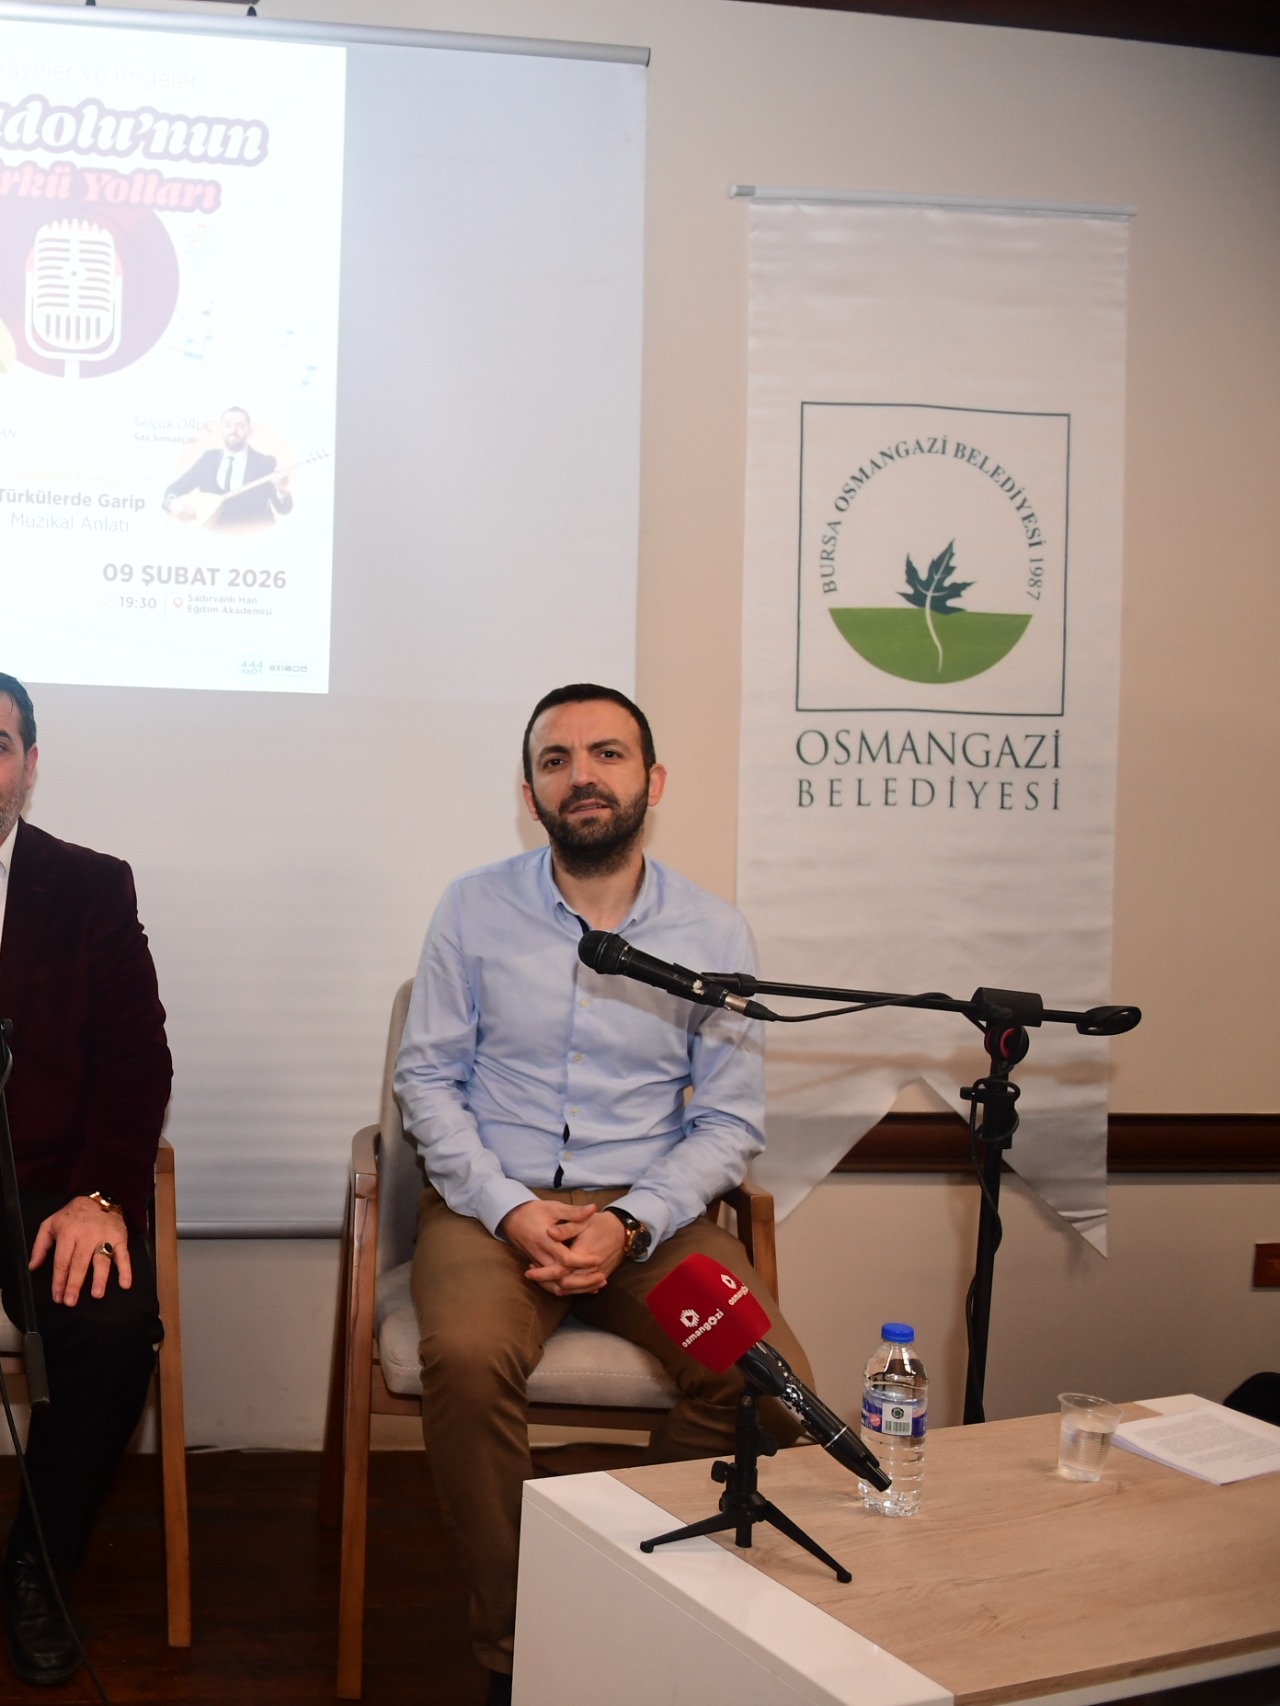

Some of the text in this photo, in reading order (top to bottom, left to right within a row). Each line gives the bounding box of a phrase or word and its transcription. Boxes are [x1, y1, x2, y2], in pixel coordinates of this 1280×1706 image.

[81, 167, 219, 211] Yolları
[133, 416, 216, 434] Selçuk ORUÇ
[133, 432, 150, 442] Saz
[98, 493, 146, 512] Garip
[80, 515, 129, 533] Anlatı
[820, 435, 1047, 601] BURSA OSMANGAZİ BELEDİYESİ 1987
[102, 562, 287, 590] 09 ŞUBAT 2026
[119, 596, 158, 610] 19:30
[239, 595, 258, 605] Han
[187, 604, 273, 617] Eğitim Akademisi
[796, 729, 1062, 769] OSMANGAZİ
[797, 776, 1060, 811] BELEDİYESİ
